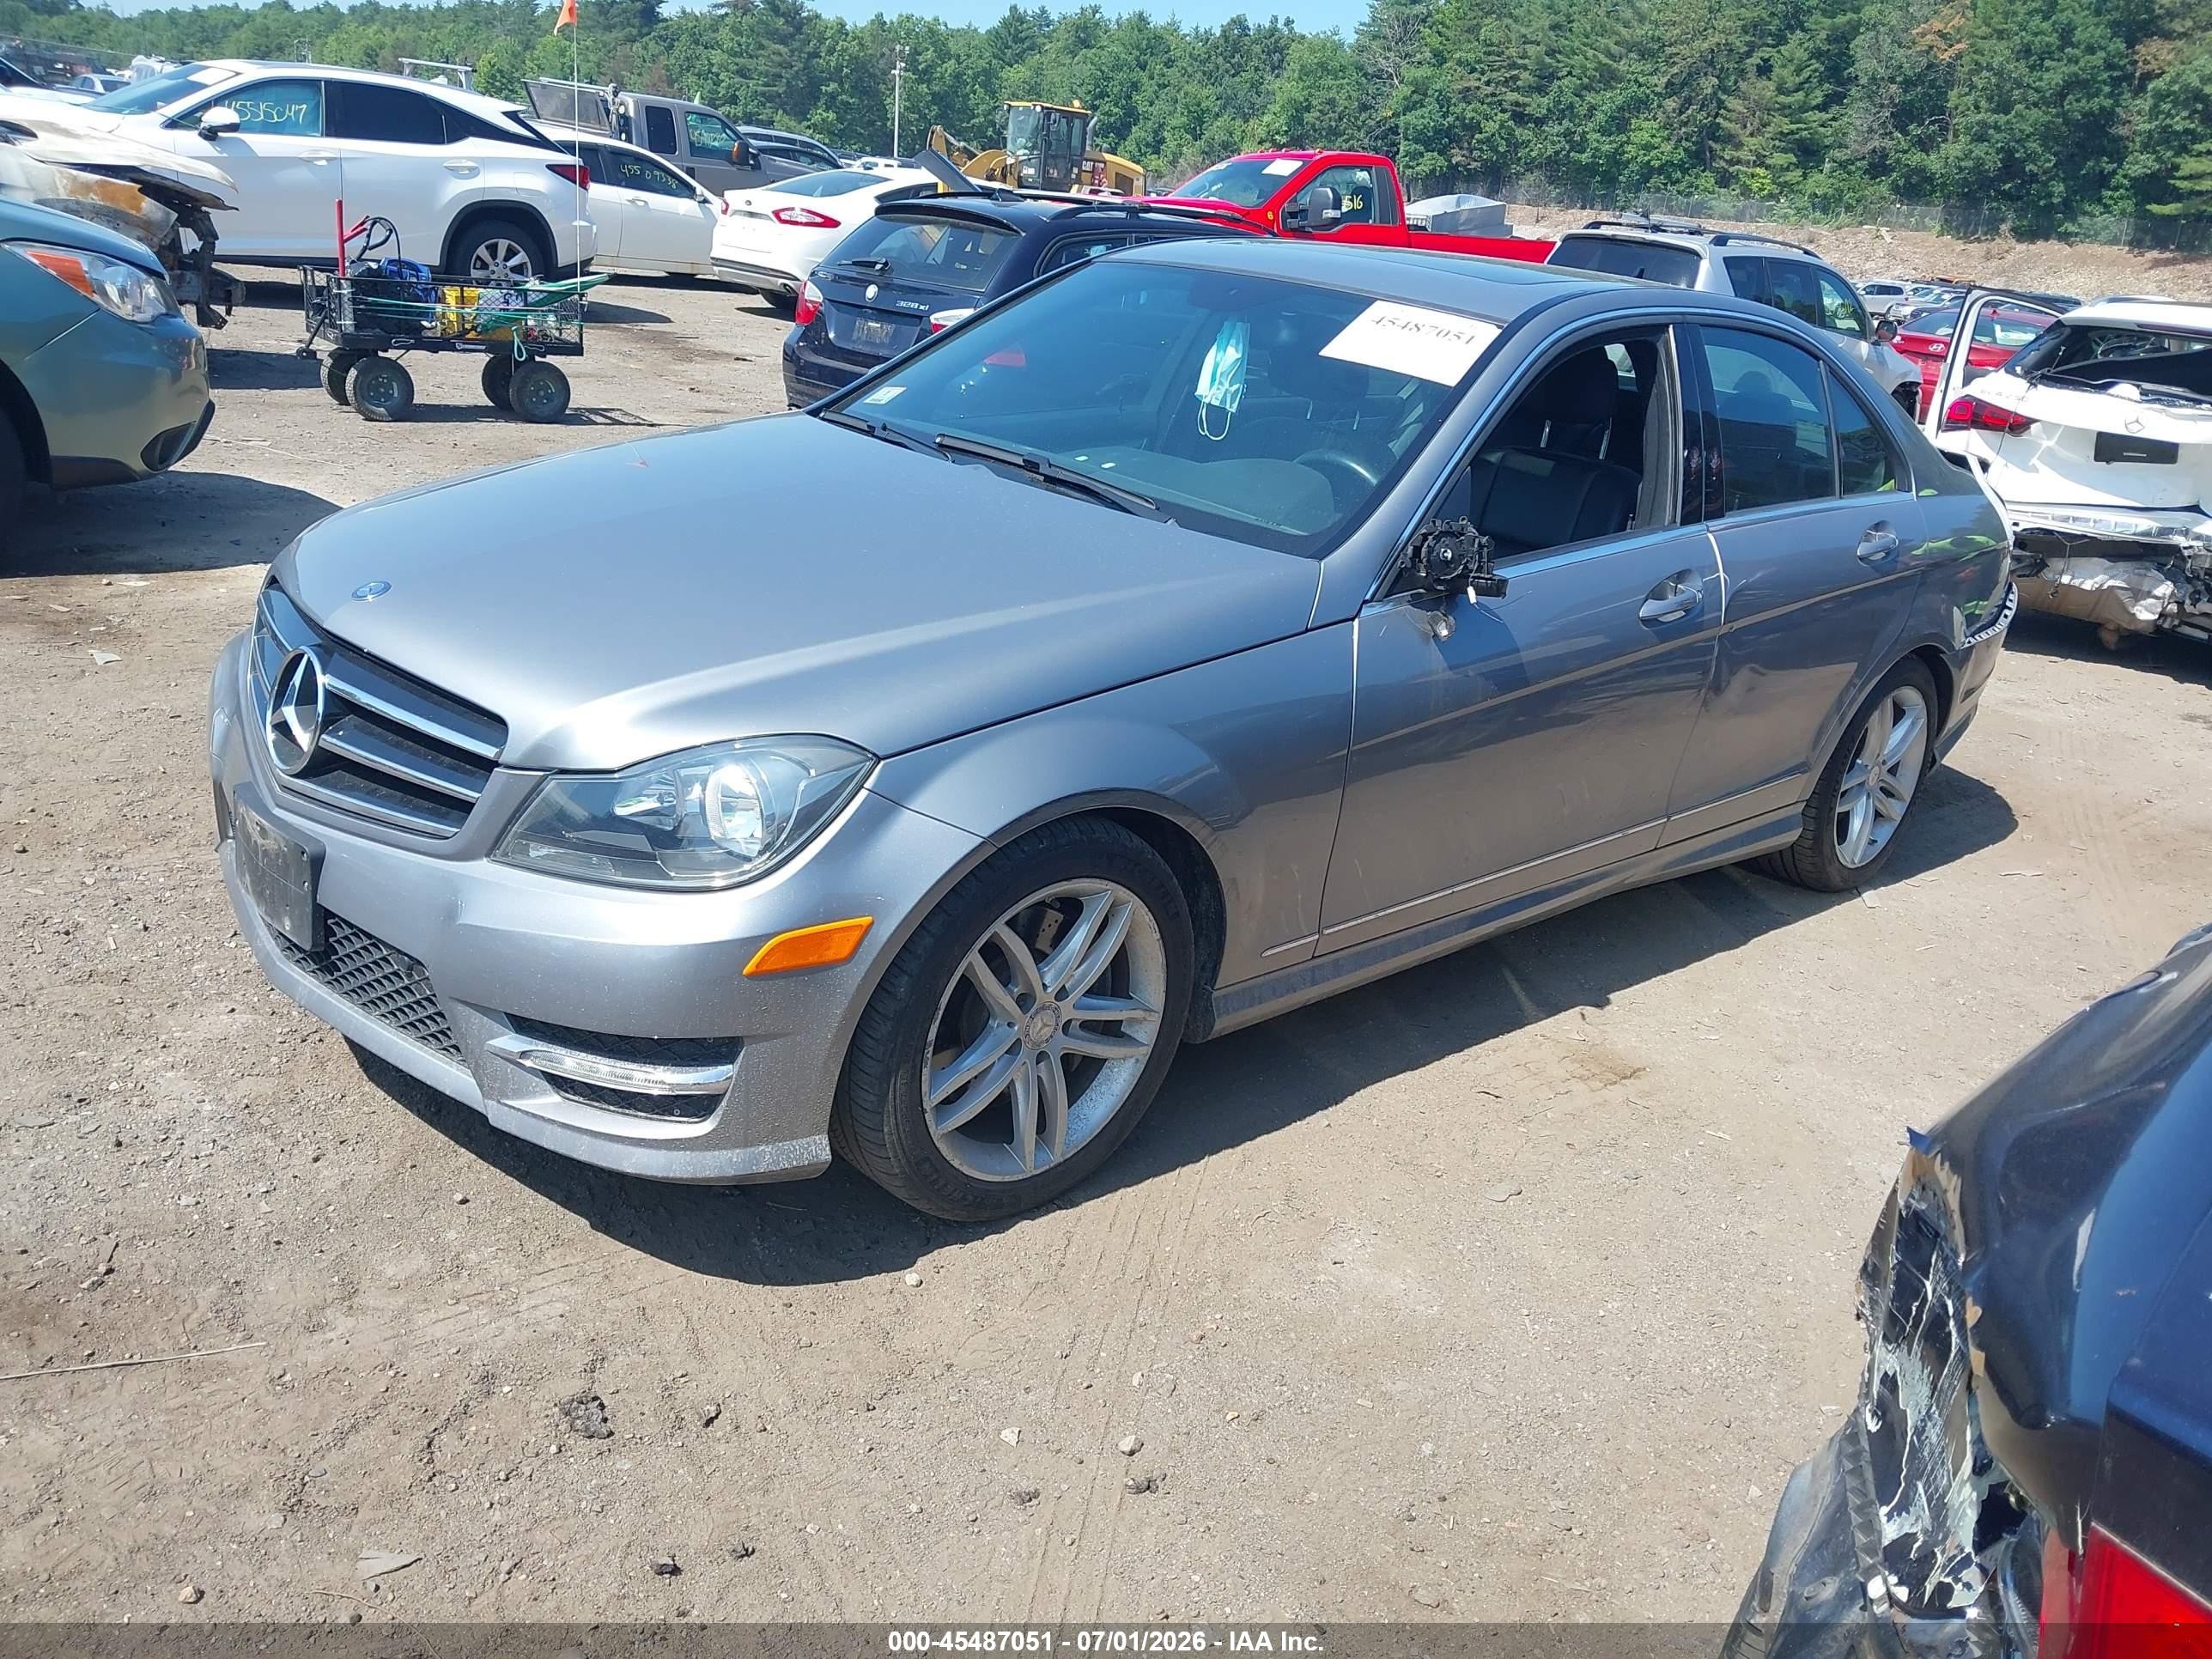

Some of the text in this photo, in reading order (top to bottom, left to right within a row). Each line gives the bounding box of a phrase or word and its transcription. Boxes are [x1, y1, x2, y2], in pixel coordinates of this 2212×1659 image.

[620, 164, 641, 178] 455
[1082, 161, 1093, 172] CAT
[1371, 315, 1475, 344] 45487051
